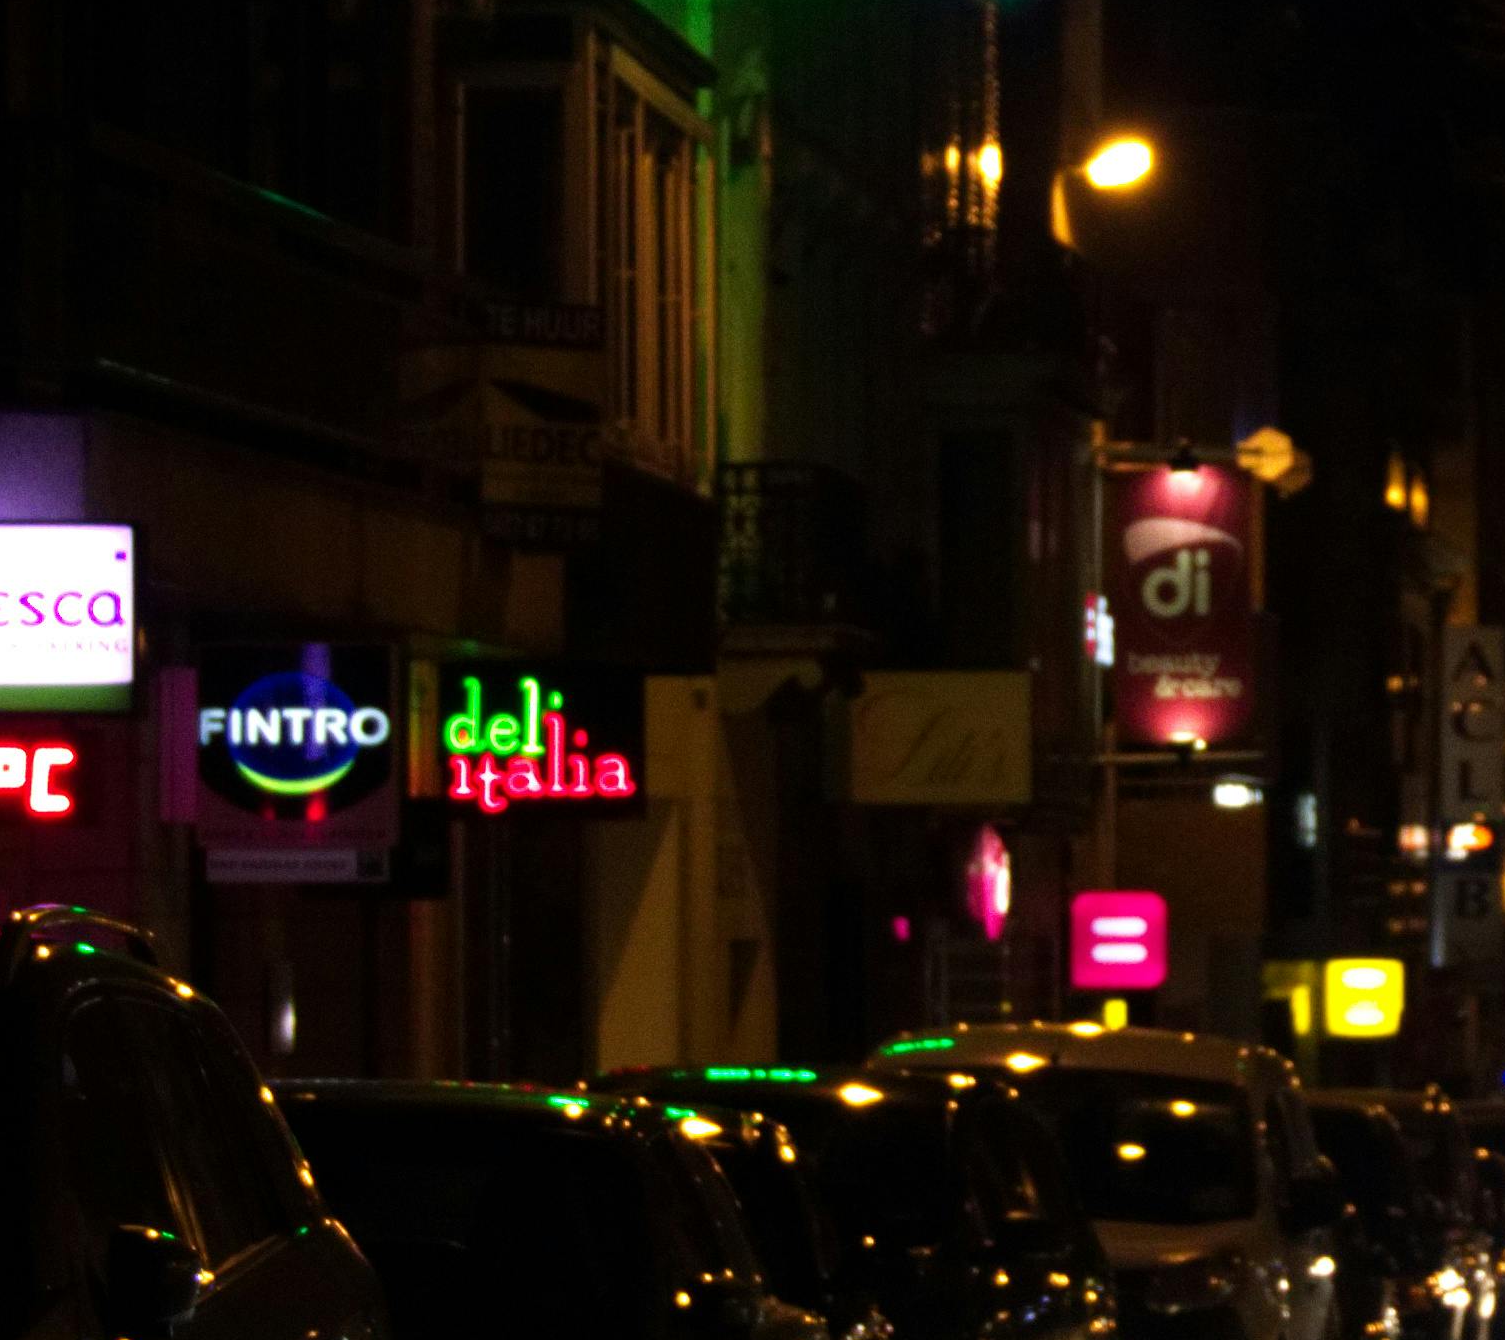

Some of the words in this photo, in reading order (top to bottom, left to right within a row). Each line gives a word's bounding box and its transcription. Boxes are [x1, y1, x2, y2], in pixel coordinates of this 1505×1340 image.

[1140, 547, 1213, 618] di
[198, 705, 392, 748] FINTRO
[445, 676, 566, 756] deli
[448, 712, 637, 814] italia
